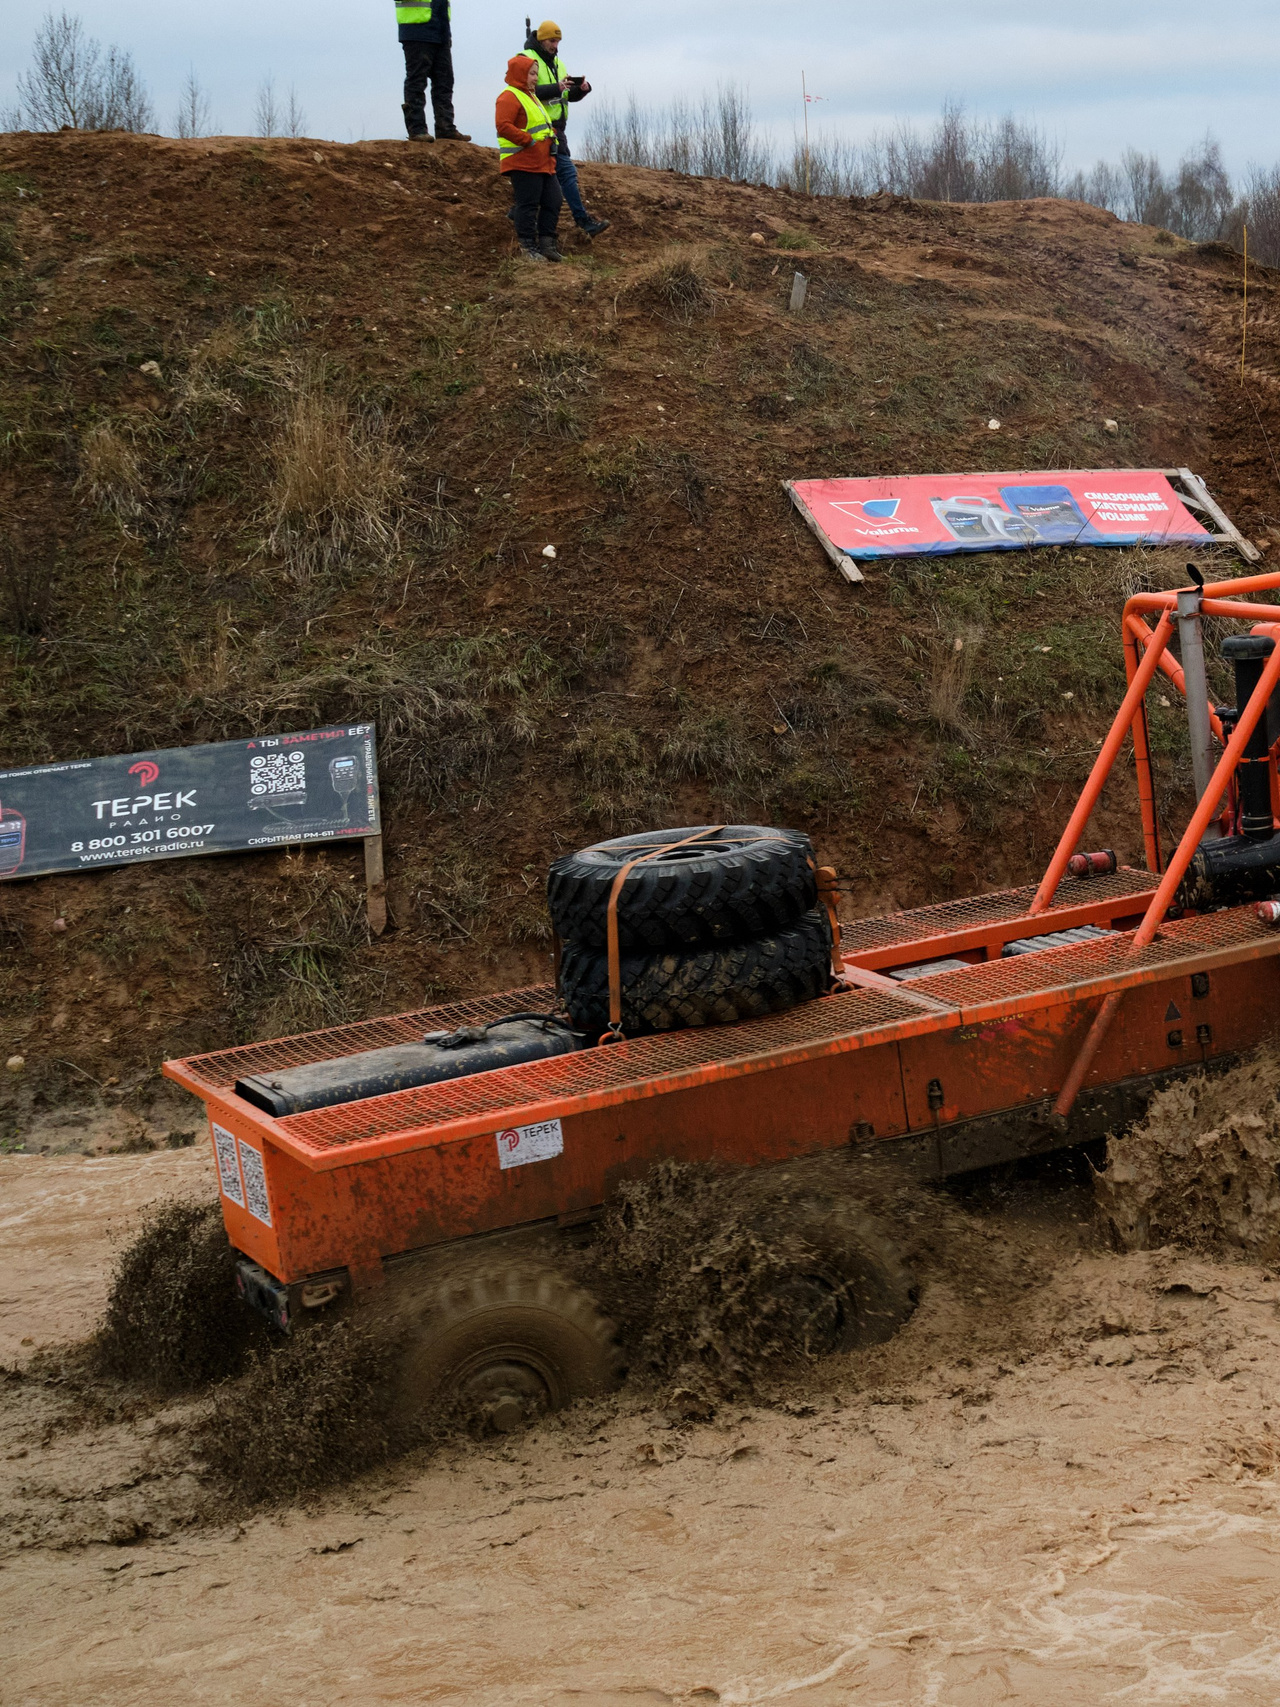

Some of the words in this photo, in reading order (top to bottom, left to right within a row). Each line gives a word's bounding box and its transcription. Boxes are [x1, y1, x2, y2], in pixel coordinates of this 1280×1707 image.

[1083, 492, 1162, 502] СМАЗОЧНЫЕ
[1090, 501, 1169, 511] МАТЕРИАЛЫ
[1097, 511, 1150, 521] VOLUME
[855, 527, 919, 536] Volume
[259, 738, 279, 748] ТЫ
[282, 729, 345, 745] ЗАМЕТИЛ
[348, 725, 371, 736] ЕЁ?
[70, 762, 93, 770] ТЕРЕК
[363, 739, 373, 784] УПРАВЛЕНИЕМ
[91, 789, 197, 819] ТЕРЕК
[109, 813, 182, 829] РАДИО
[71, 841, 84, 852] 8
[88, 835, 126, 850] 800
[130, 829, 161, 844] 301
[166, 824, 216, 839] 6007
[247, 833, 302, 845] СКРЫТНАЯ
[80, 840, 204, 862] www.terek-radio.ru
[522, 1121, 559, 1139] ТЕРЕК
